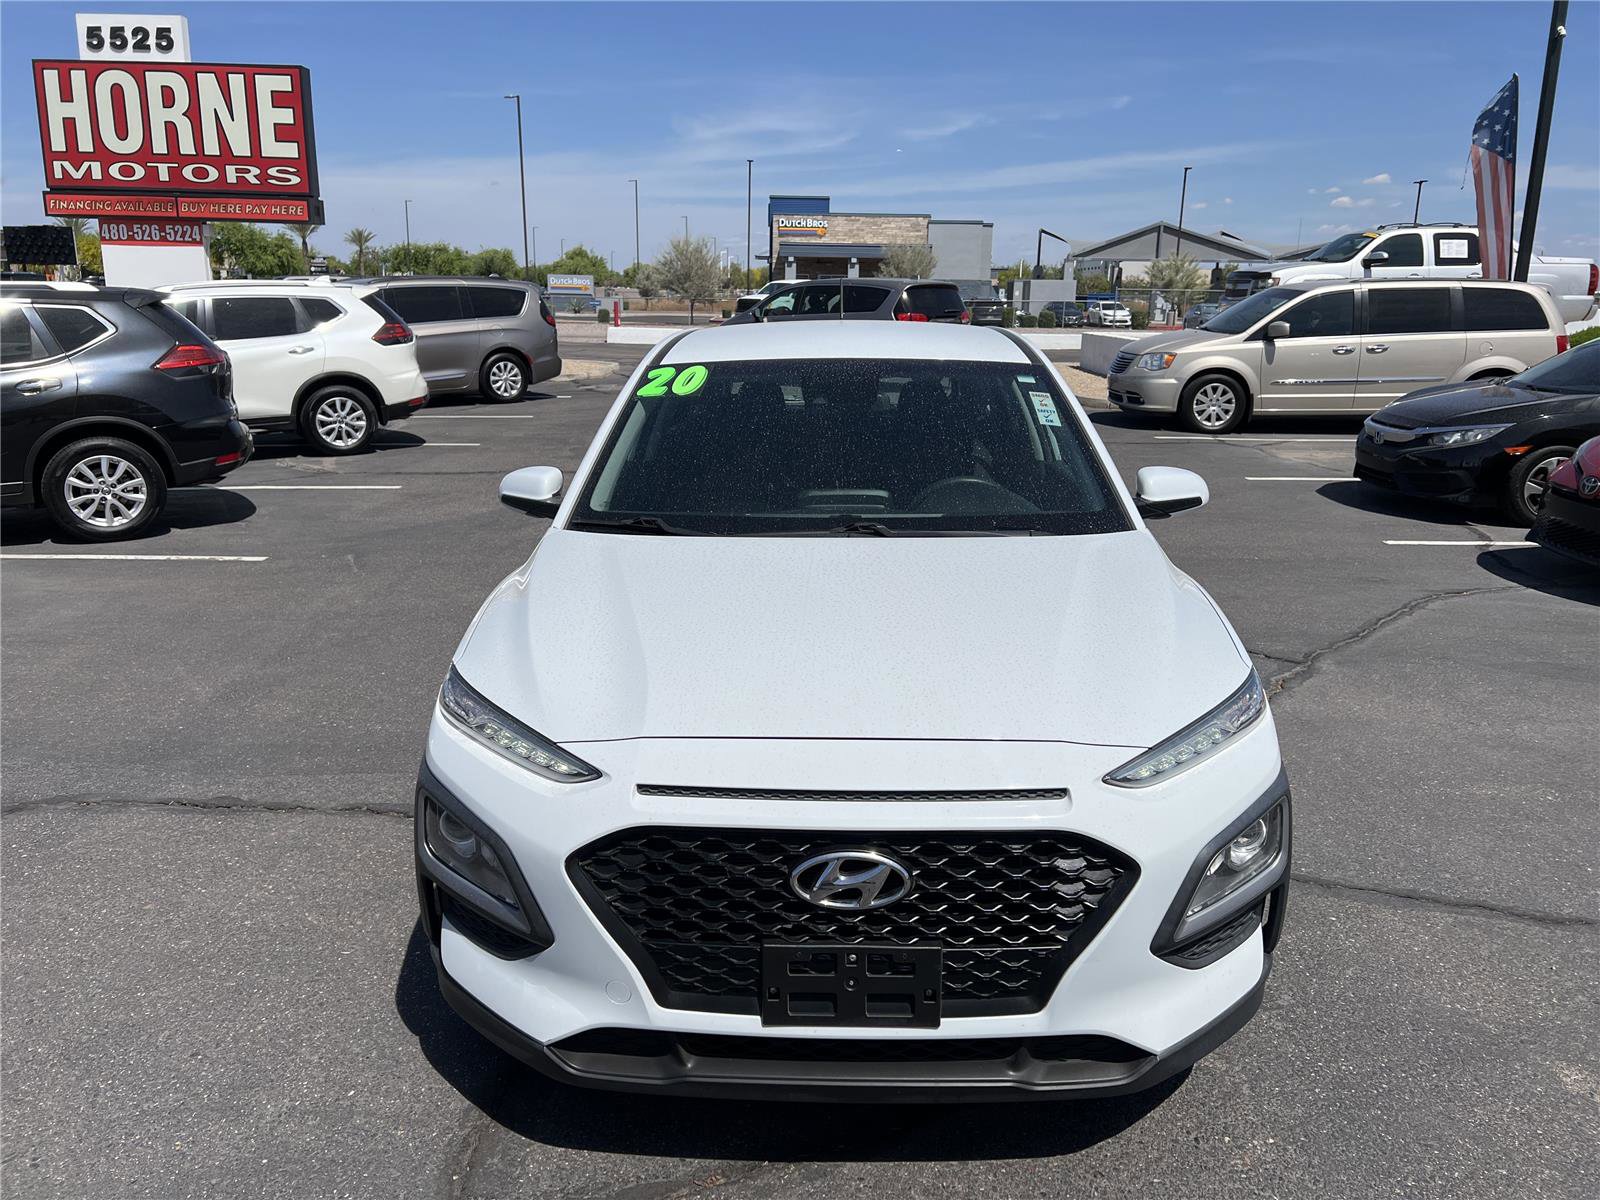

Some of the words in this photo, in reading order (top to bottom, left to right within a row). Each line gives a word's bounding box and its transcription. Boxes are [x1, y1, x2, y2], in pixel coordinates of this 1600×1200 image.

[85, 26, 174, 54] 5525
[41, 68, 300, 159] HORNE
[52, 160, 302, 186] MOTORS
[49, 199, 112, 211] FINANCING
[114, 201, 174, 212] AVAILABLE
[181, 202, 207, 213] BUY
[210, 203, 242, 214] HERE
[245, 204, 268, 215] PAY
[271, 205, 304, 216] HERE
[101, 223, 200, 242] 480-526-5224
[636, 365, 709, 398] 20
